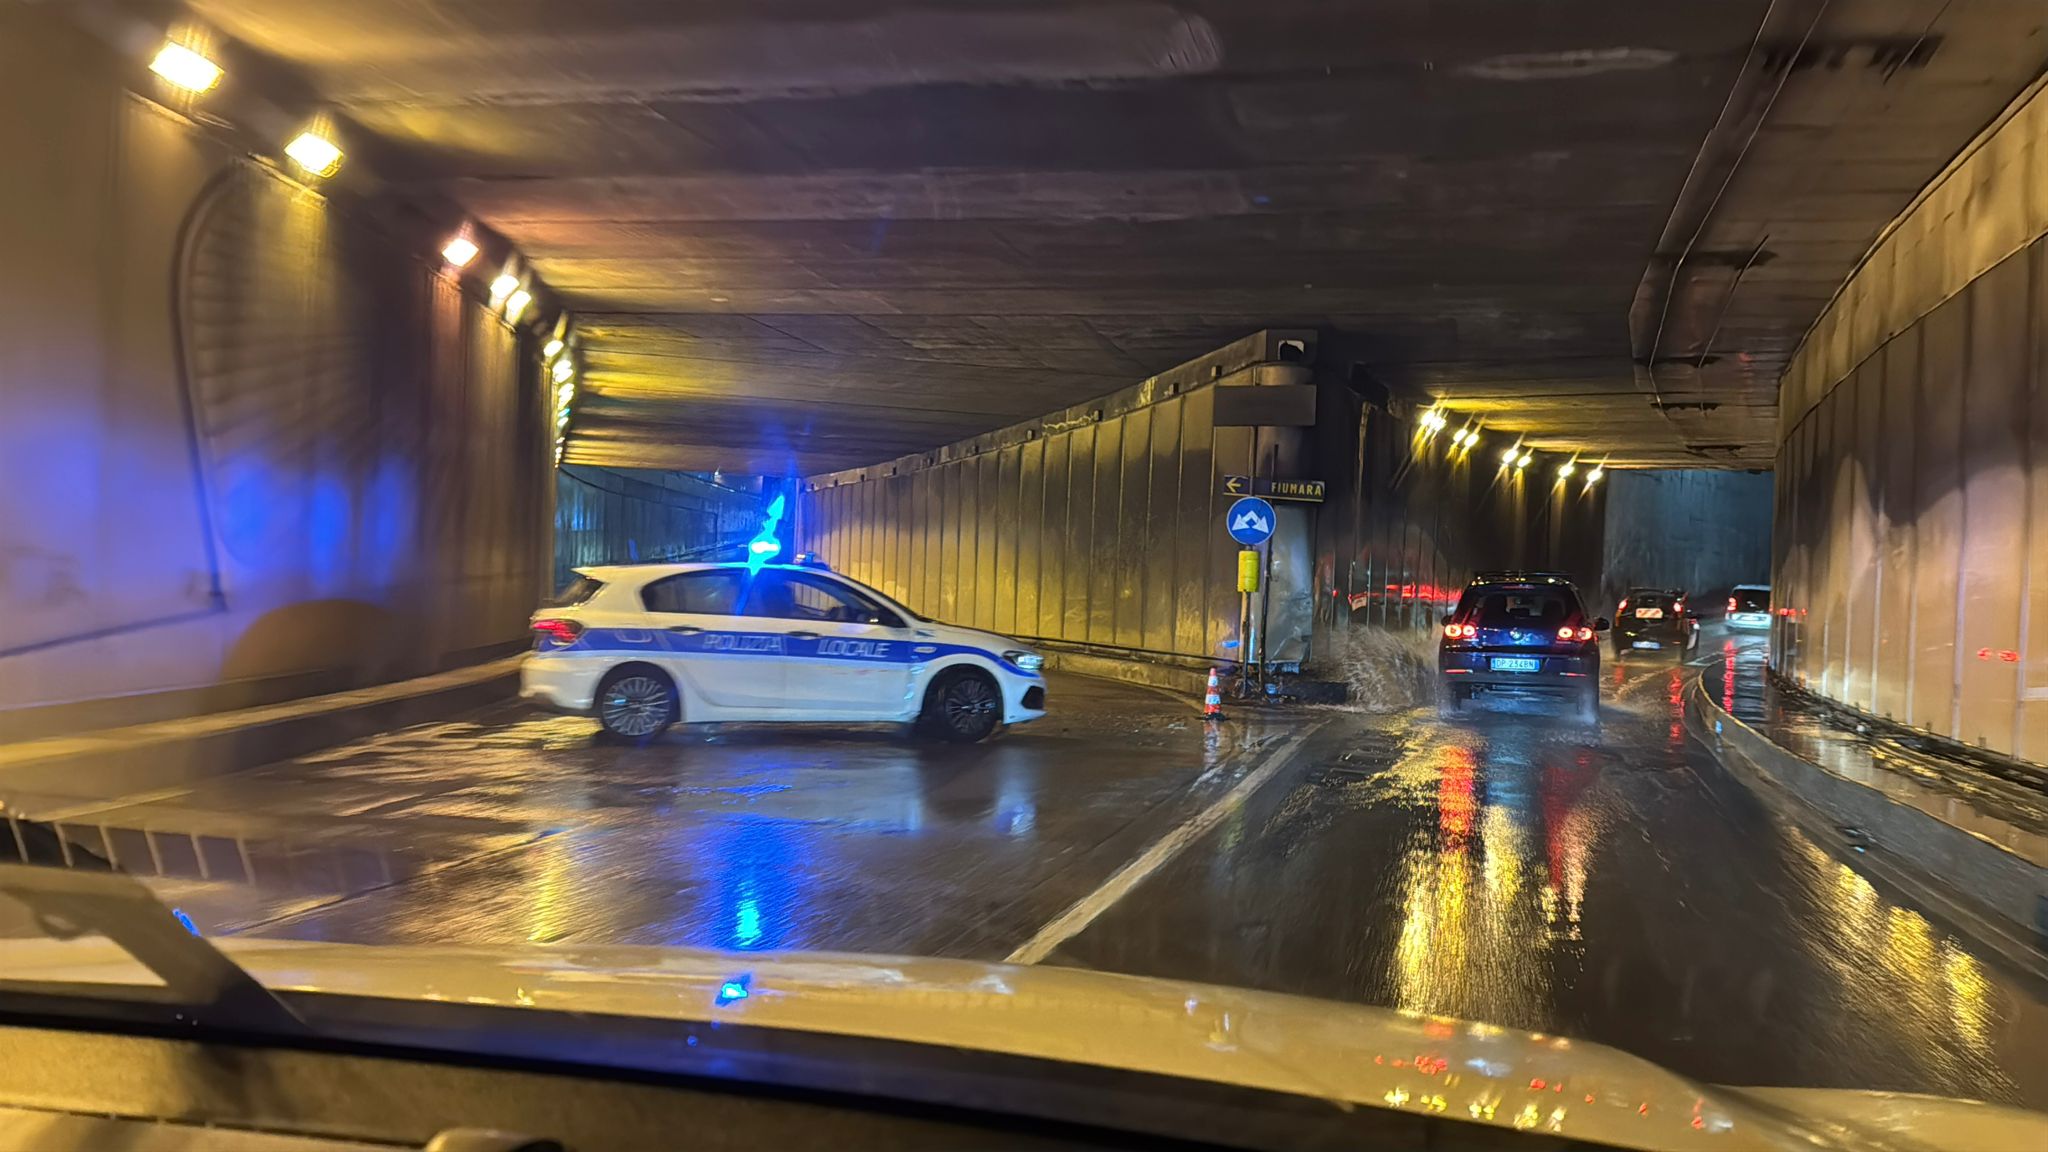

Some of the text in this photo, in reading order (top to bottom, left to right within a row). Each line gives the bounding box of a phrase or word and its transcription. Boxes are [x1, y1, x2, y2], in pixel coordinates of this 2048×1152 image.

[1271, 482, 1322, 496] FIUMARA
[703, 634, 891, 658] POLIZIA LOCALE
